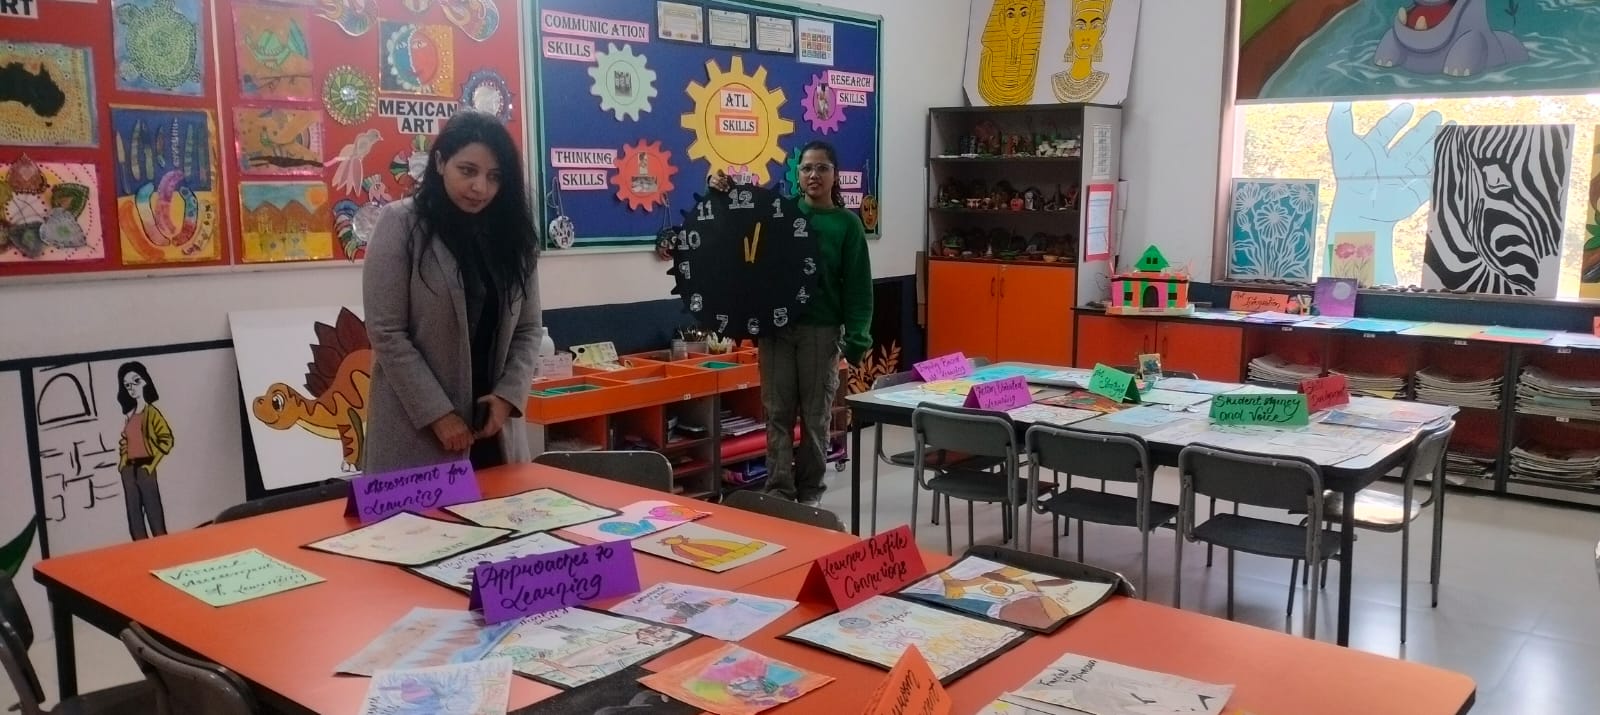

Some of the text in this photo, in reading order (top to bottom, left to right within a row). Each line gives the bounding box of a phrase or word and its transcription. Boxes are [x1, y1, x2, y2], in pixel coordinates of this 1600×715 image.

[1, 0, 33, 15] RT
[544, 14, 646, 38] COMMUNICATION
[547, 41, 591, 57] SKILLS
[831, 74, 871, 87] RESEARCH
[725, 93, 749, 108] ATL
[839, 92, 865, 104] SKILLS
[379, 100, 458, 117] MEXICAN
[401, 118, 434, 133] ART
[722, 119, 755, 131] SKILLS
[555, 151, 613, 165] THINKING
[562, 173, 604, 186] SKILLS
[728, 188, 755, 209] 12
[771, 198, 785, 218] 1
[696, 200, 715, 220] 11
[792, 217, 809, 237] 2
[677, 230, 701, 250] 10
[678, 261, 691, 280] 9
[803, 257, 817, 275] 3
[690, 293, 703, 312] 8
[715, 314, 729, 333] 7
[773, 307, 788, 327] 5
[1215, 395, 1262, 408] Student
[1219, 406, 1294, 423] and Voice
[363, 463, 468, 496] Assessment for
[363, 487, 443, 515] Learning
[823, 531, 908, 580] Learner Profile
[480, 550, 590, 595] Approaches
[595, 545, 614, 563] to
[500, 573, 603, 612] Learning
